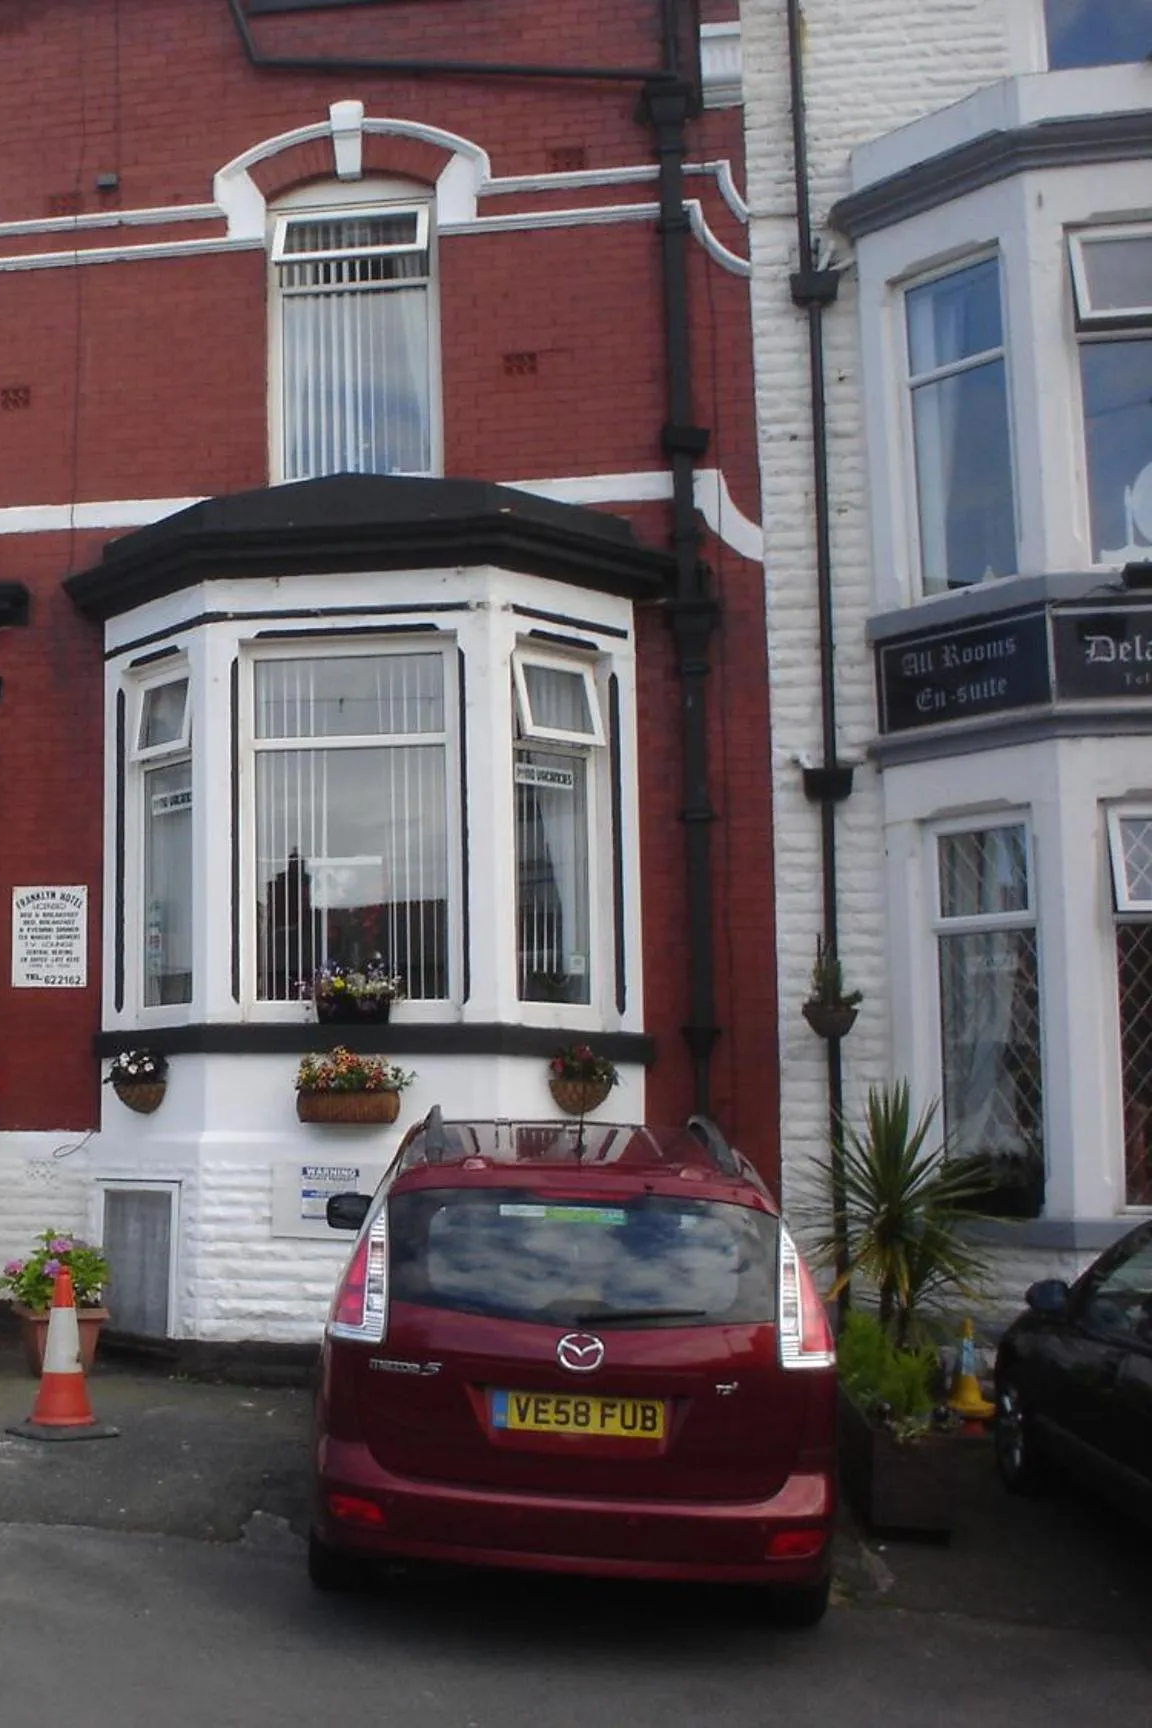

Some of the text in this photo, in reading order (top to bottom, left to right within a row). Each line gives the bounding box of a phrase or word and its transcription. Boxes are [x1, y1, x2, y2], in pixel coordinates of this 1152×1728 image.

[901, 635, 1017, 677] All Rooms
[59, 893, 83, 909] HOTEL
[307, 1167, 356, 1177] WARNING
[515, 1396, 658, 1432] VE58 FUB
